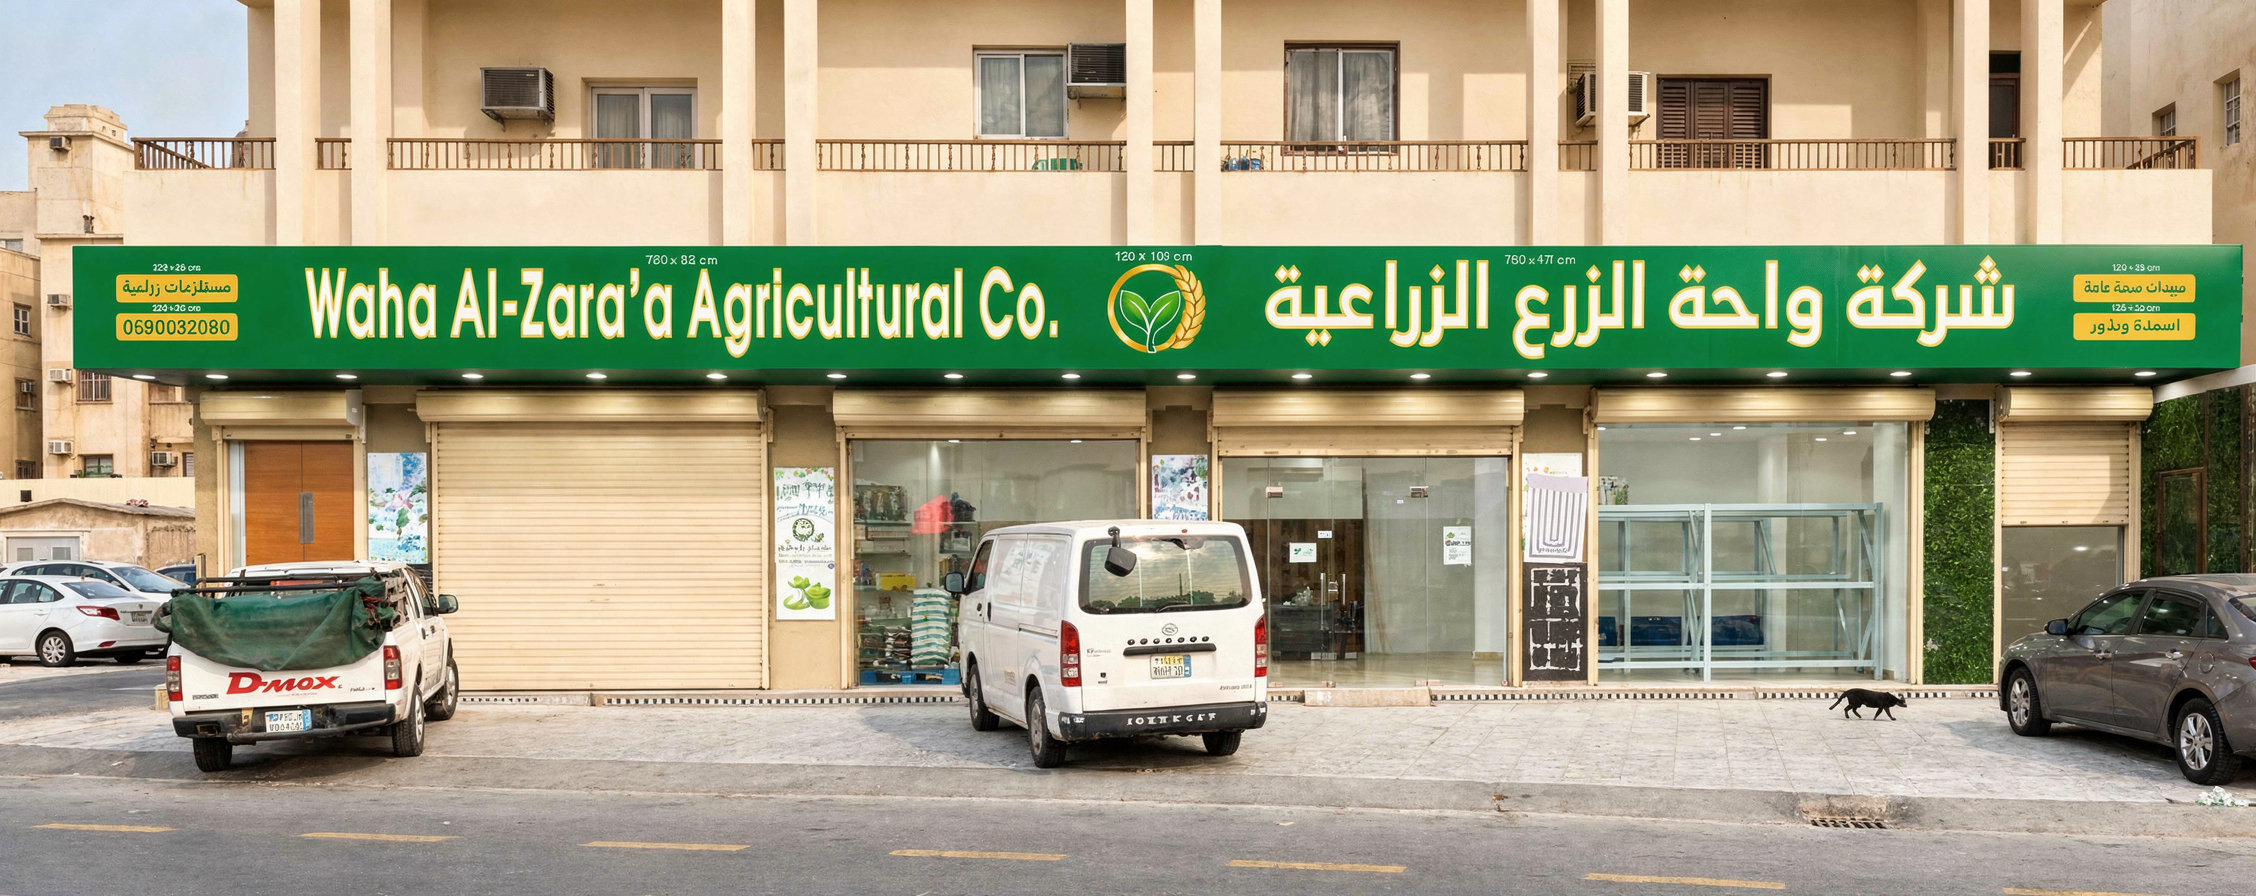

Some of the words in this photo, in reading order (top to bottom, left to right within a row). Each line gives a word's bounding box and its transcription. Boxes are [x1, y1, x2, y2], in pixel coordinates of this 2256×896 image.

[699, 257, 718, 265] cm
[1115, 251, 1136, 262] 120
[1173, 253, 1193, 262] cm
[1557, 256, 1576, 265] cm
[122, 319, 231, 336] 0690032080
[304, 267, 437, 340] Waha
[686, 267, 964, 359] Agricultural
[979, 265, 1059, 341] Co.
[1264, 259, 1490, 348] الزراعية
[1511, 259, 1646, 360] الزرع
[1668, 260, 1823, 348] واحة
[1846, 254, 2016, 348] شركة
